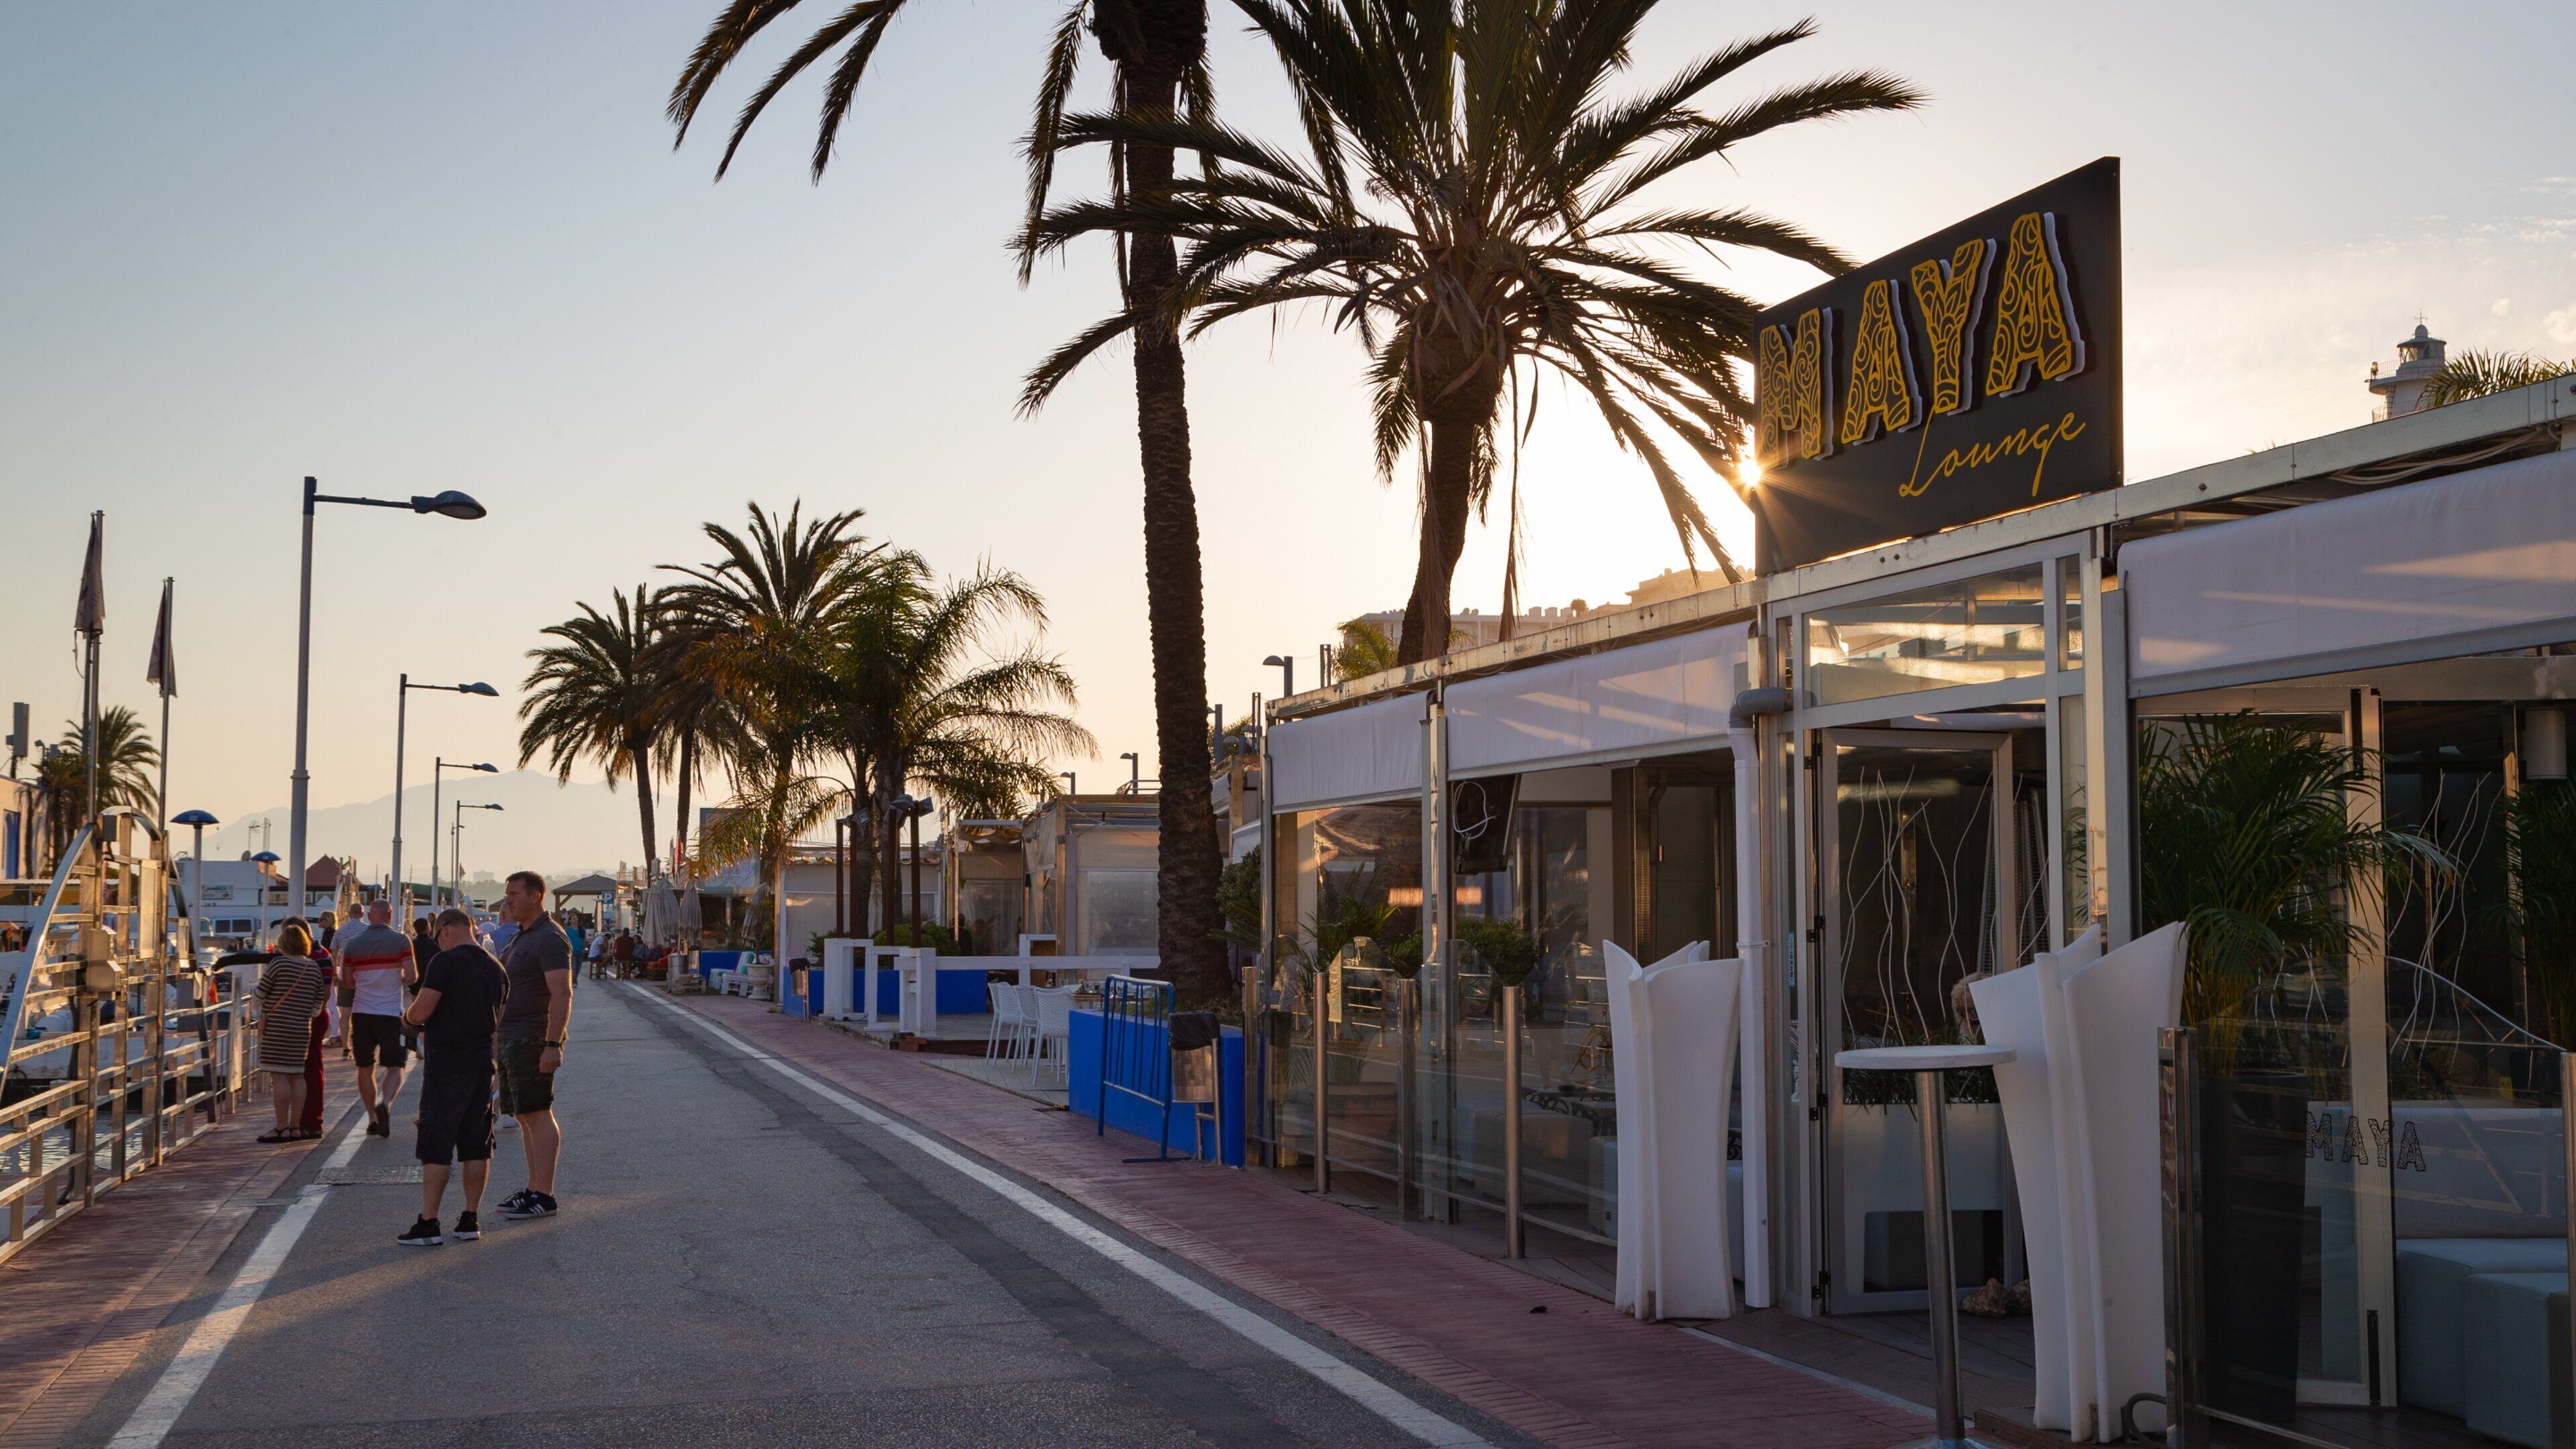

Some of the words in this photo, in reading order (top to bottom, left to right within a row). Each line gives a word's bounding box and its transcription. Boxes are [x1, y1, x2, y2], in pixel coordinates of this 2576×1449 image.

[1759, 212, 2084, 468] MAYA
[1899, 405, 2086, 496] Lounge
[604, 893, 612, 903] P
[2304, 1111, 2426, 1172] MAYA
